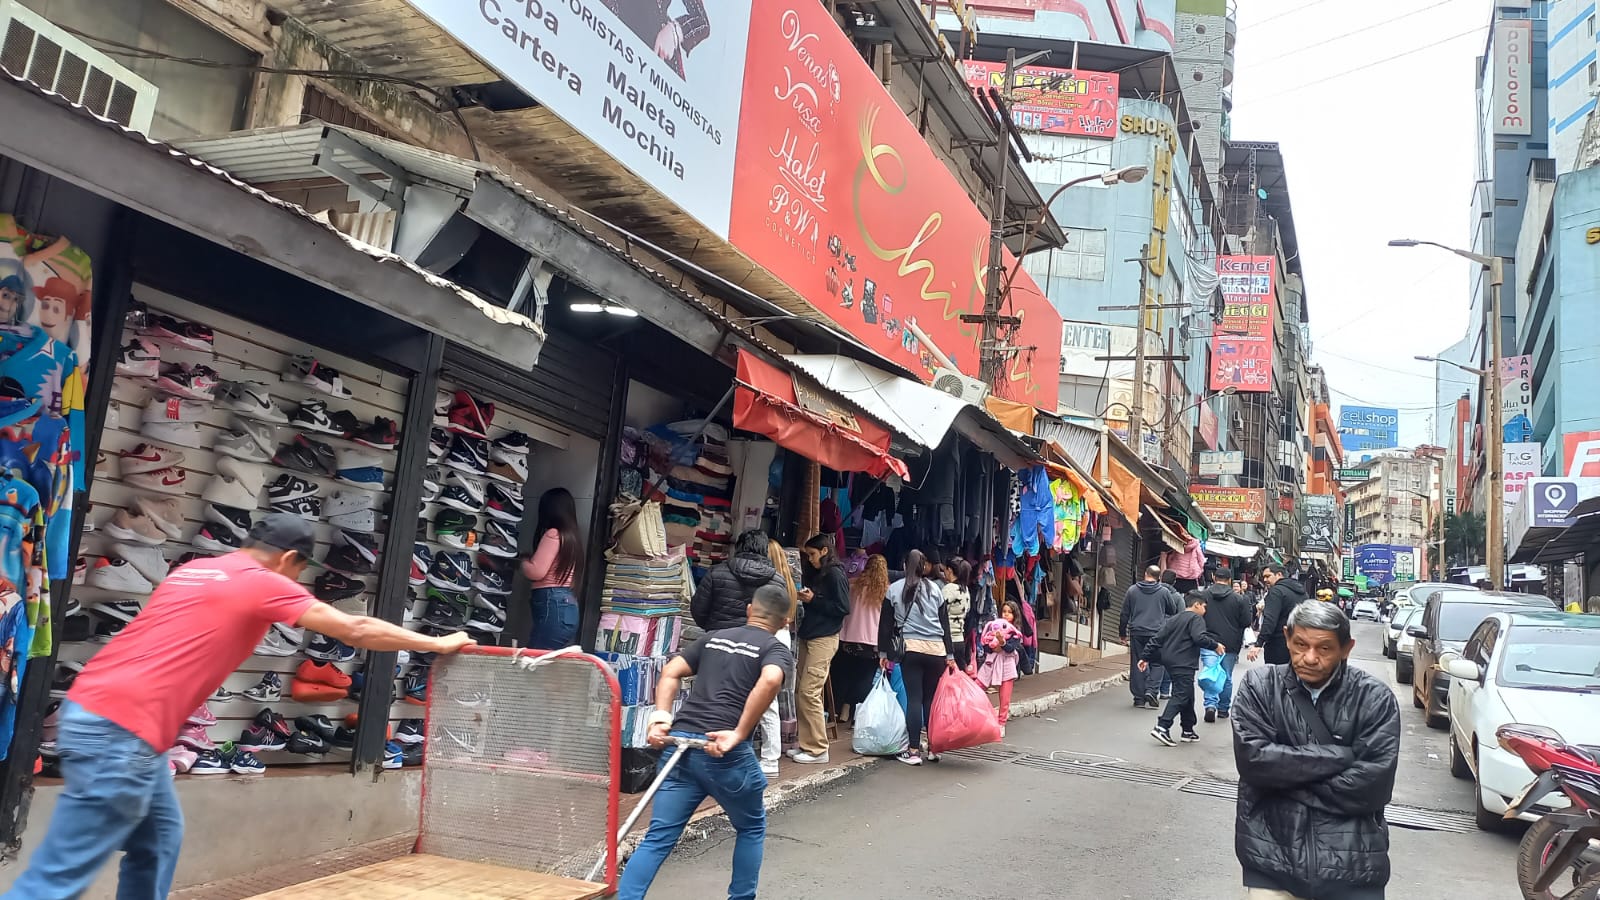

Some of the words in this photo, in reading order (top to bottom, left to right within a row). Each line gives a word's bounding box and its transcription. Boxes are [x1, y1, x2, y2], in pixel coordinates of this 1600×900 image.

[480, 0, 582, 97] Cartera
[516, 0, 559, 36] pa
[562, 0, 634, 64] ORISTAS
[638, 56, 648, 75] Y
[650, 68, 722, 146] MINORISTAS
[606, 61, 677, 139] Maleta
[1503, 30, 1523, 127] pontocom
[602, 96, 685, 181] Mochila
[1220, 259, 1270, 272] Kemei
[1064, 325, 1109, 350] ENTER
[1504, 472, 1534, 481] ASA
